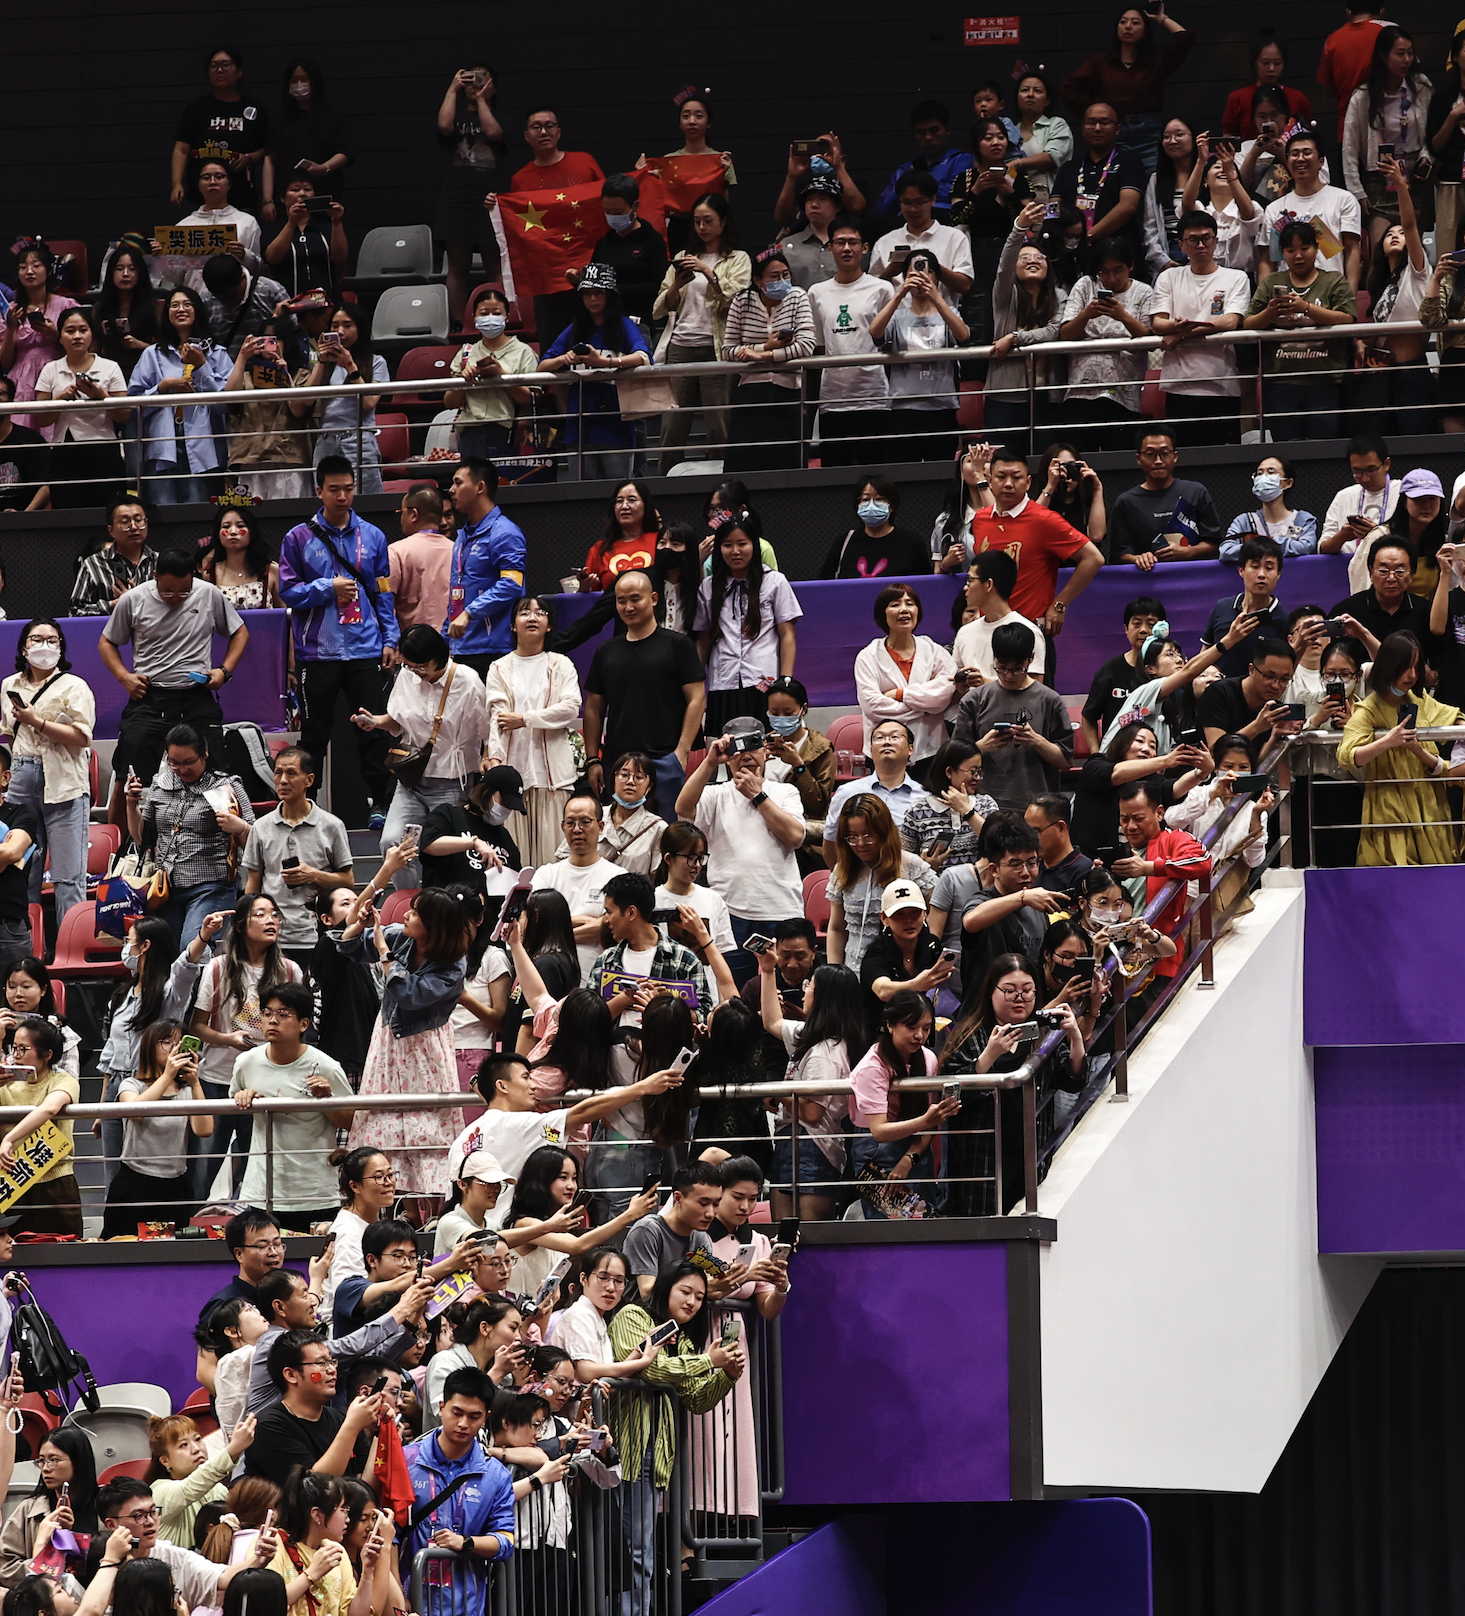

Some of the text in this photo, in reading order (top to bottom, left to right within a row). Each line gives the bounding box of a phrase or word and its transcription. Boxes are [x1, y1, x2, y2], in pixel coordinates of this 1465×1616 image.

[209, 116, 245, 132] 中国
[168, 228, 226, 250] 樊振东
